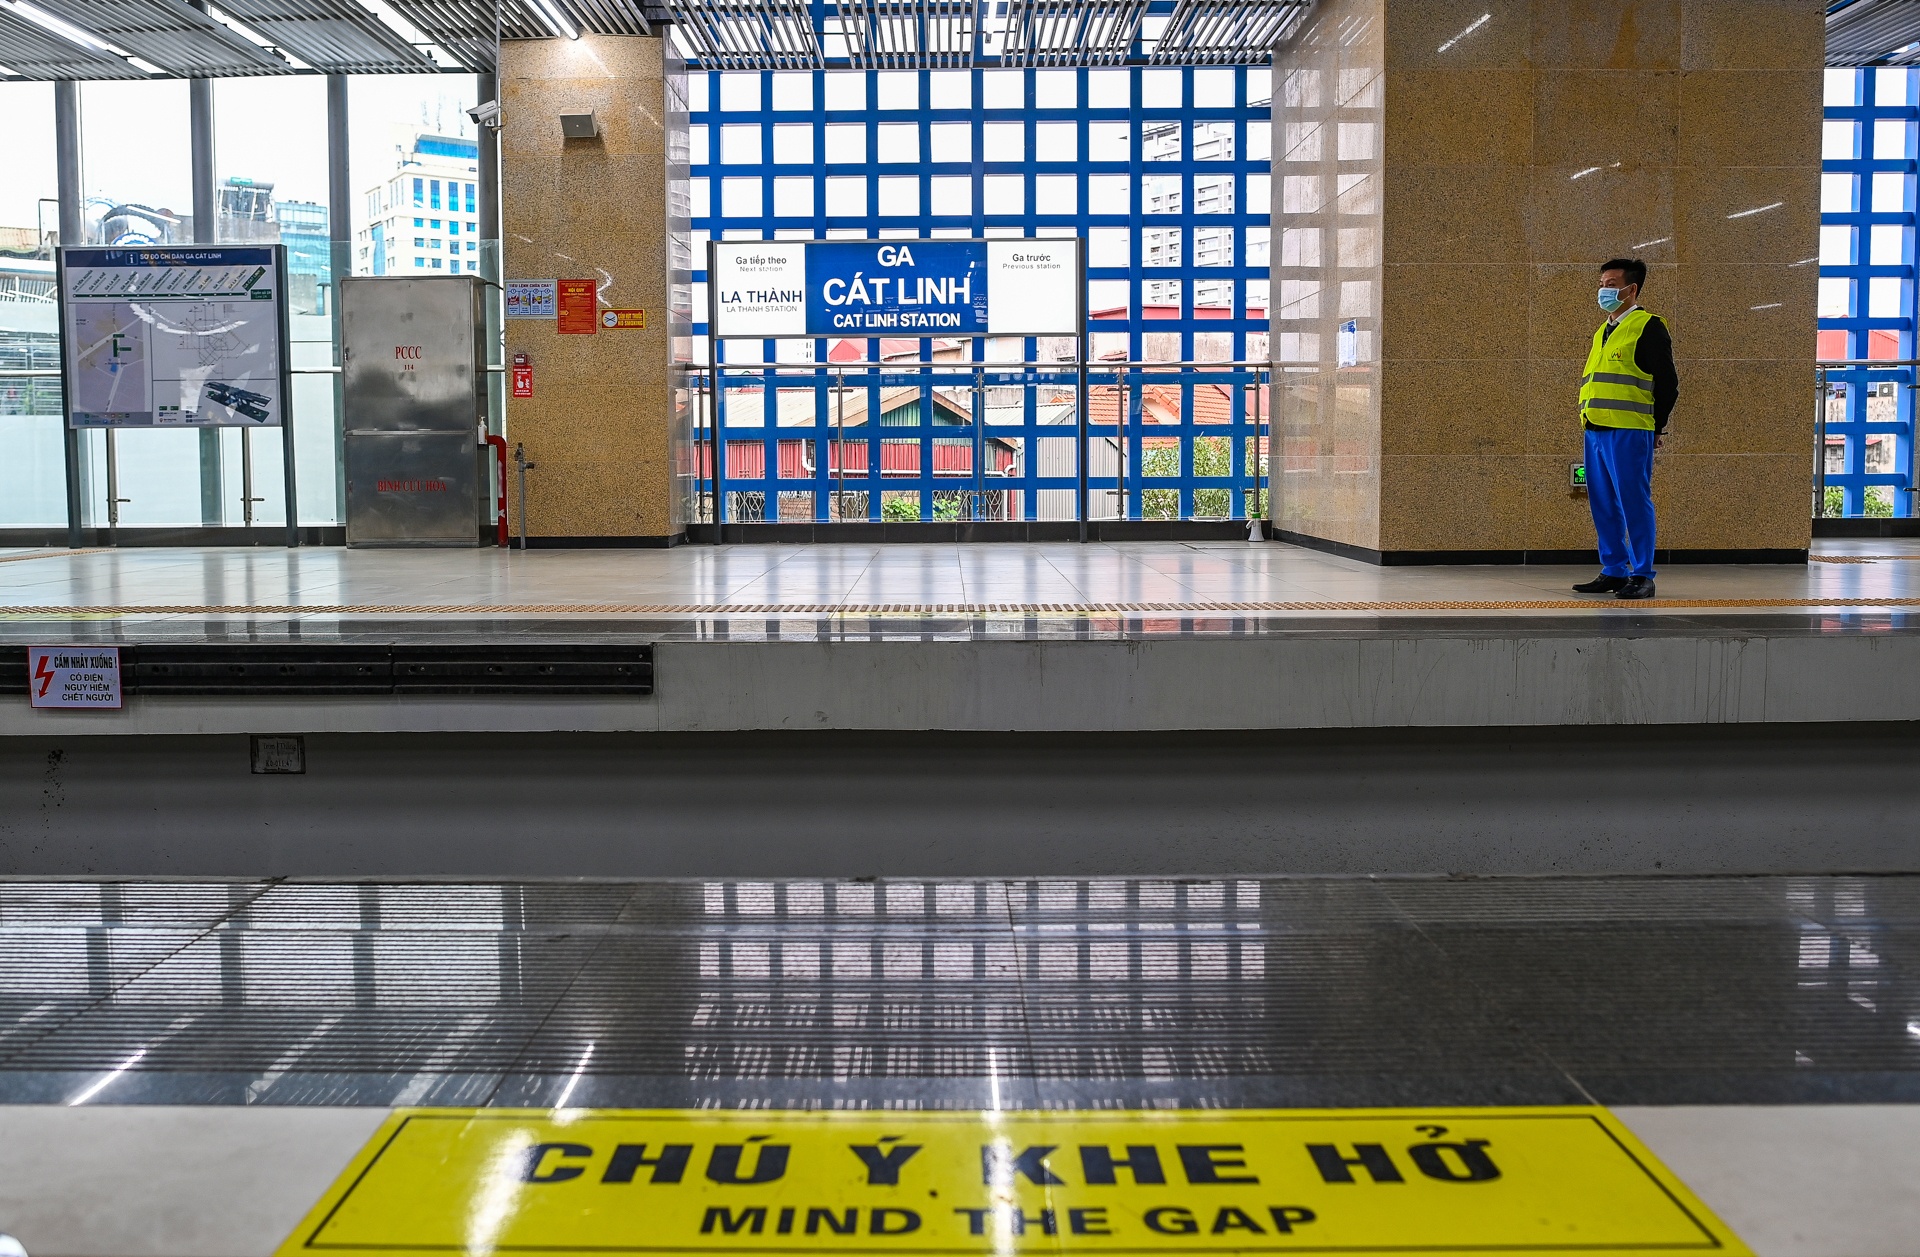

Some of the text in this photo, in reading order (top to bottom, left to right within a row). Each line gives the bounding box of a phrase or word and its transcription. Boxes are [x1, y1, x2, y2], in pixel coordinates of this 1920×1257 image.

[735, 255, 787, 266] Ga tiếp theo
[877, 245, 915, 267] GA
[1012, 253, 1051, 262] Ga trước
[721, 287, 802, 303] LA THÀNH
[823, 272, 970, 306] CÁT LINH
[834, 312, 961, 328] CAT LINH STATION
[395, 346, 422, 360] PCCC
[377, 477, 401, 492] BÌNH
[54, 652, 69, 668] CẤM
[91, 652, 113, 668] XUỐNG
[70, 672, 103, 683] CÓ ĐIỆN
[62, 692, 114, 701] CHẾT NGƯỜI
[521, 1125, 1502, 1186] CHÚ Ý KHE HỞ
[700, 1206, 1318, 1236] MIND THE GAP
